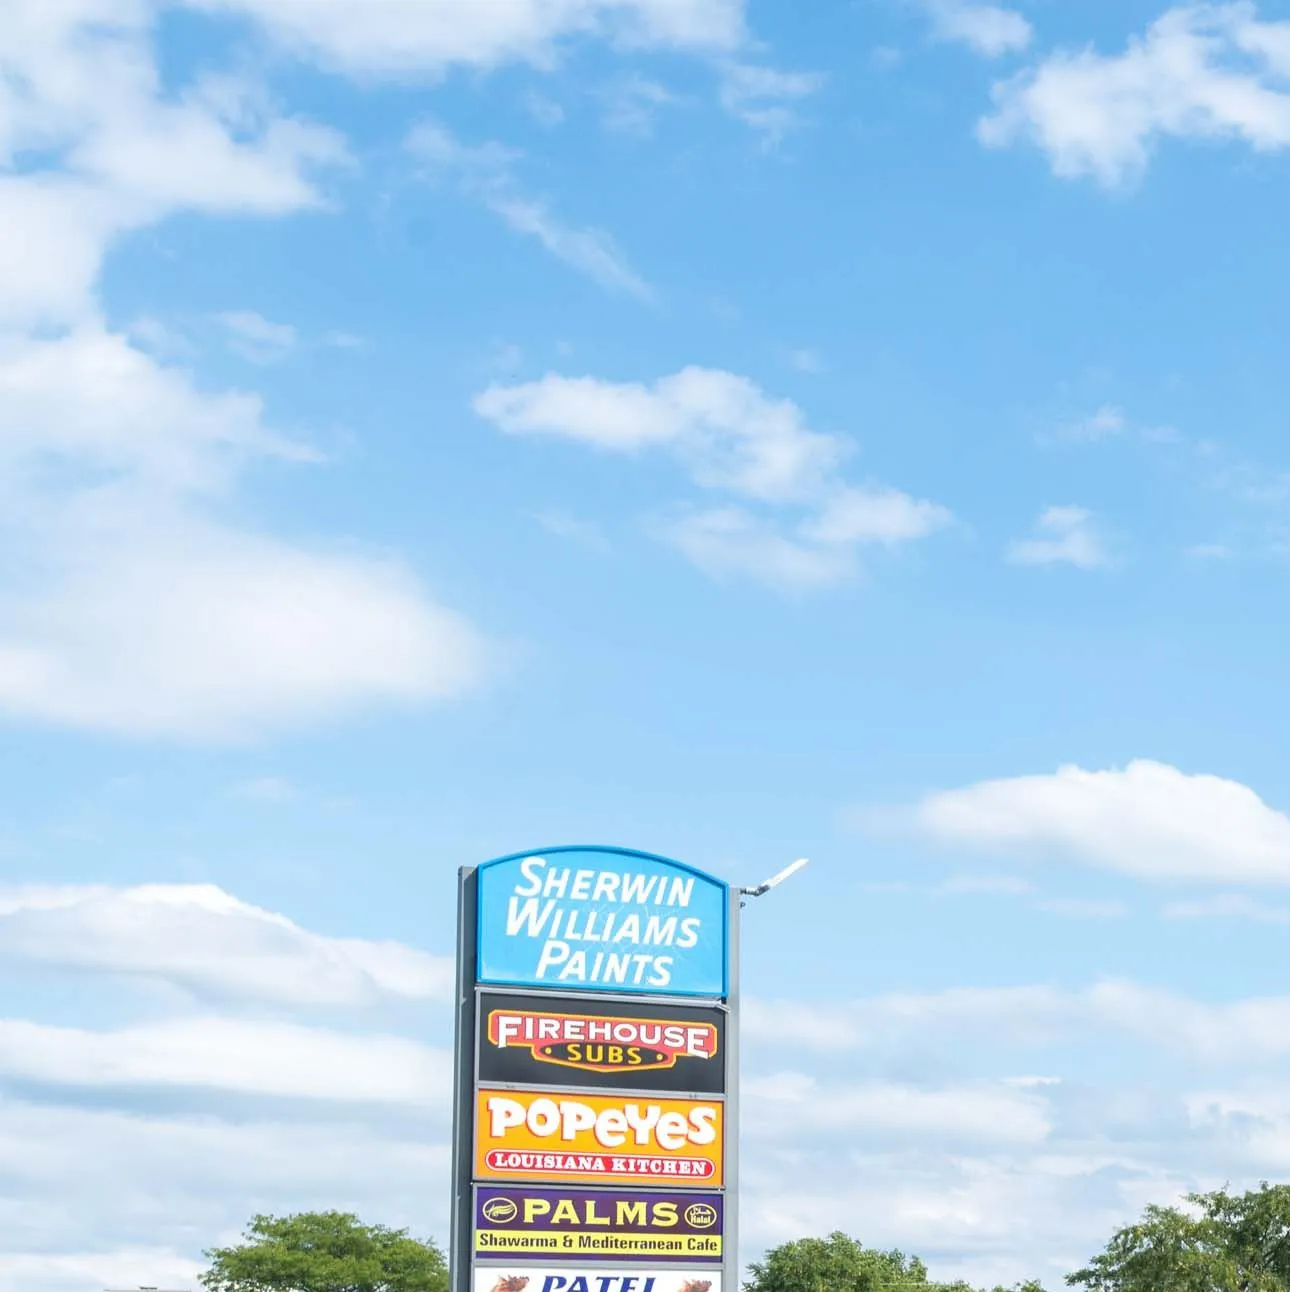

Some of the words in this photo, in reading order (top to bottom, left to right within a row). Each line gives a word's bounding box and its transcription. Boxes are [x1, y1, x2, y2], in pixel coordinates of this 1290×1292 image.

[515, 856, 695, 907] SHERWIN
[505, 896, 700, 948] WILLIAMS
[535, 940, 674, 986] PAINTS
[498, 1015, 709, 1059] FIREHOUSE
[567, 1043, 642, 1065] SUBS
[495, 1151, 605, 1172] LOUISIANA
[612, 1156, 707, 1176] KITCHEN
[523, 1198, 679, 1227] PALMS
[690, 1214, 712, 1225] Halal
[479, 1233, 558, 1249] Shawarma
[562, 1235, 574, 1249] &
[578, 1235, 683, 1250] Mediterranean
[687, 1237, 718, 1252] Cafe
